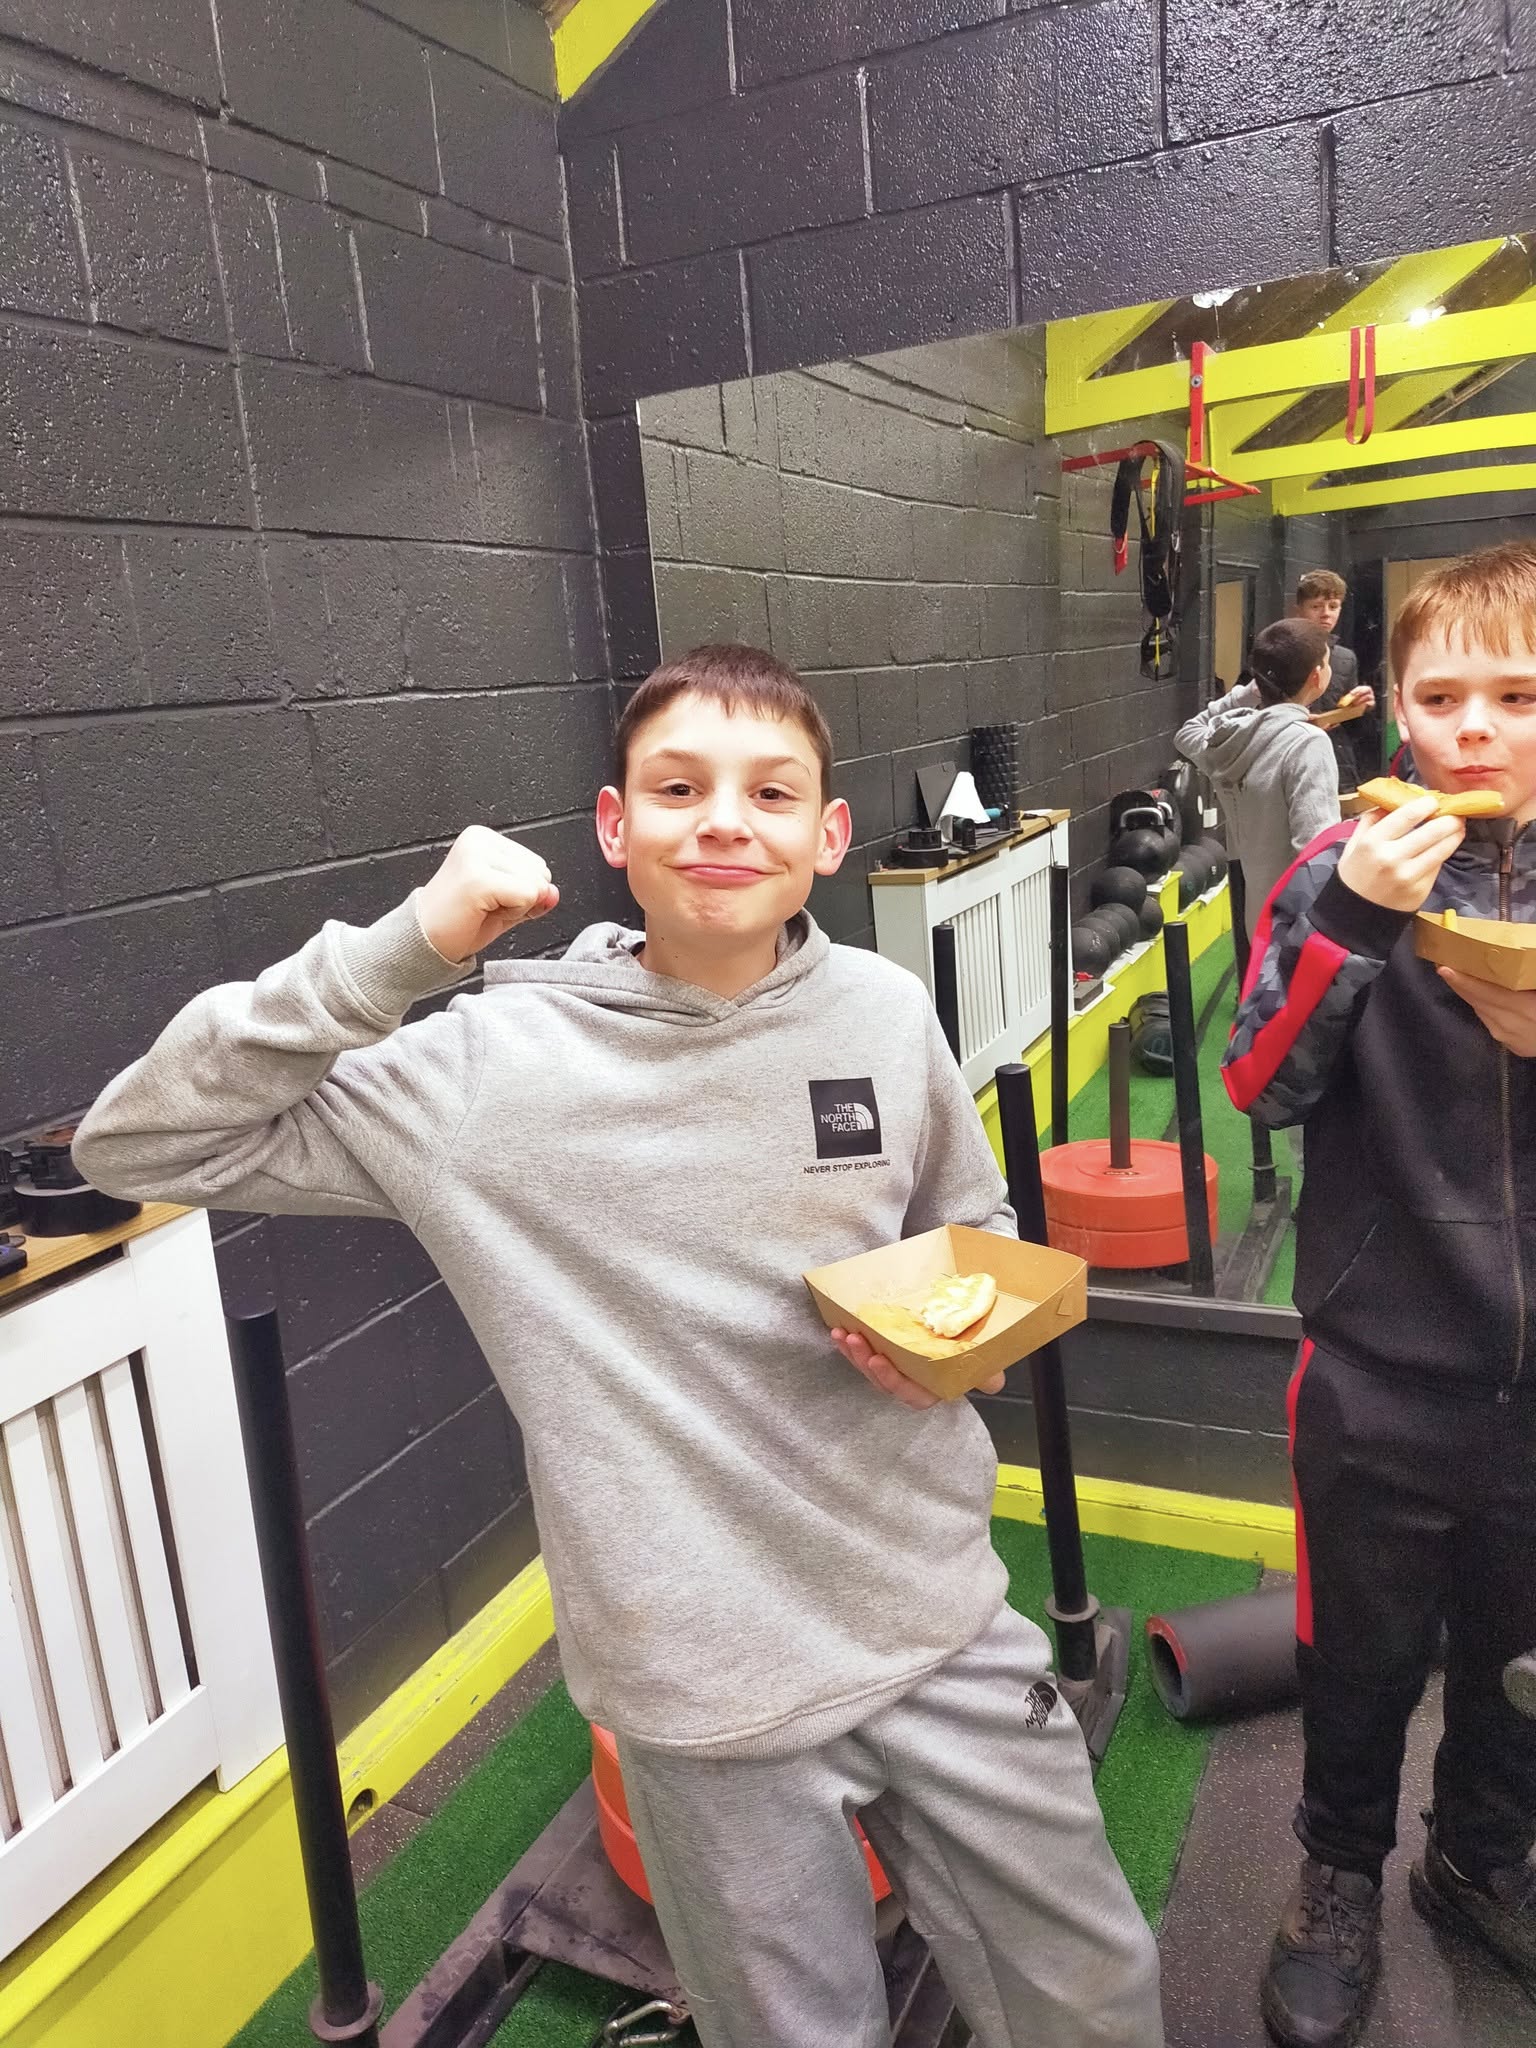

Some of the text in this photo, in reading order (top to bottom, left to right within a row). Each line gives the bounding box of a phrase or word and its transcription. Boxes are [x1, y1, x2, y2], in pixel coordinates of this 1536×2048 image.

[834, 1104, 854, 1113] THE
[820, 1113, 855, 1123] NORTH
[832, 1122, 857, 1133] FACE
[803, 1165, 831, 1174] NEVER
[833, 1163, 852, 1172] STOP
